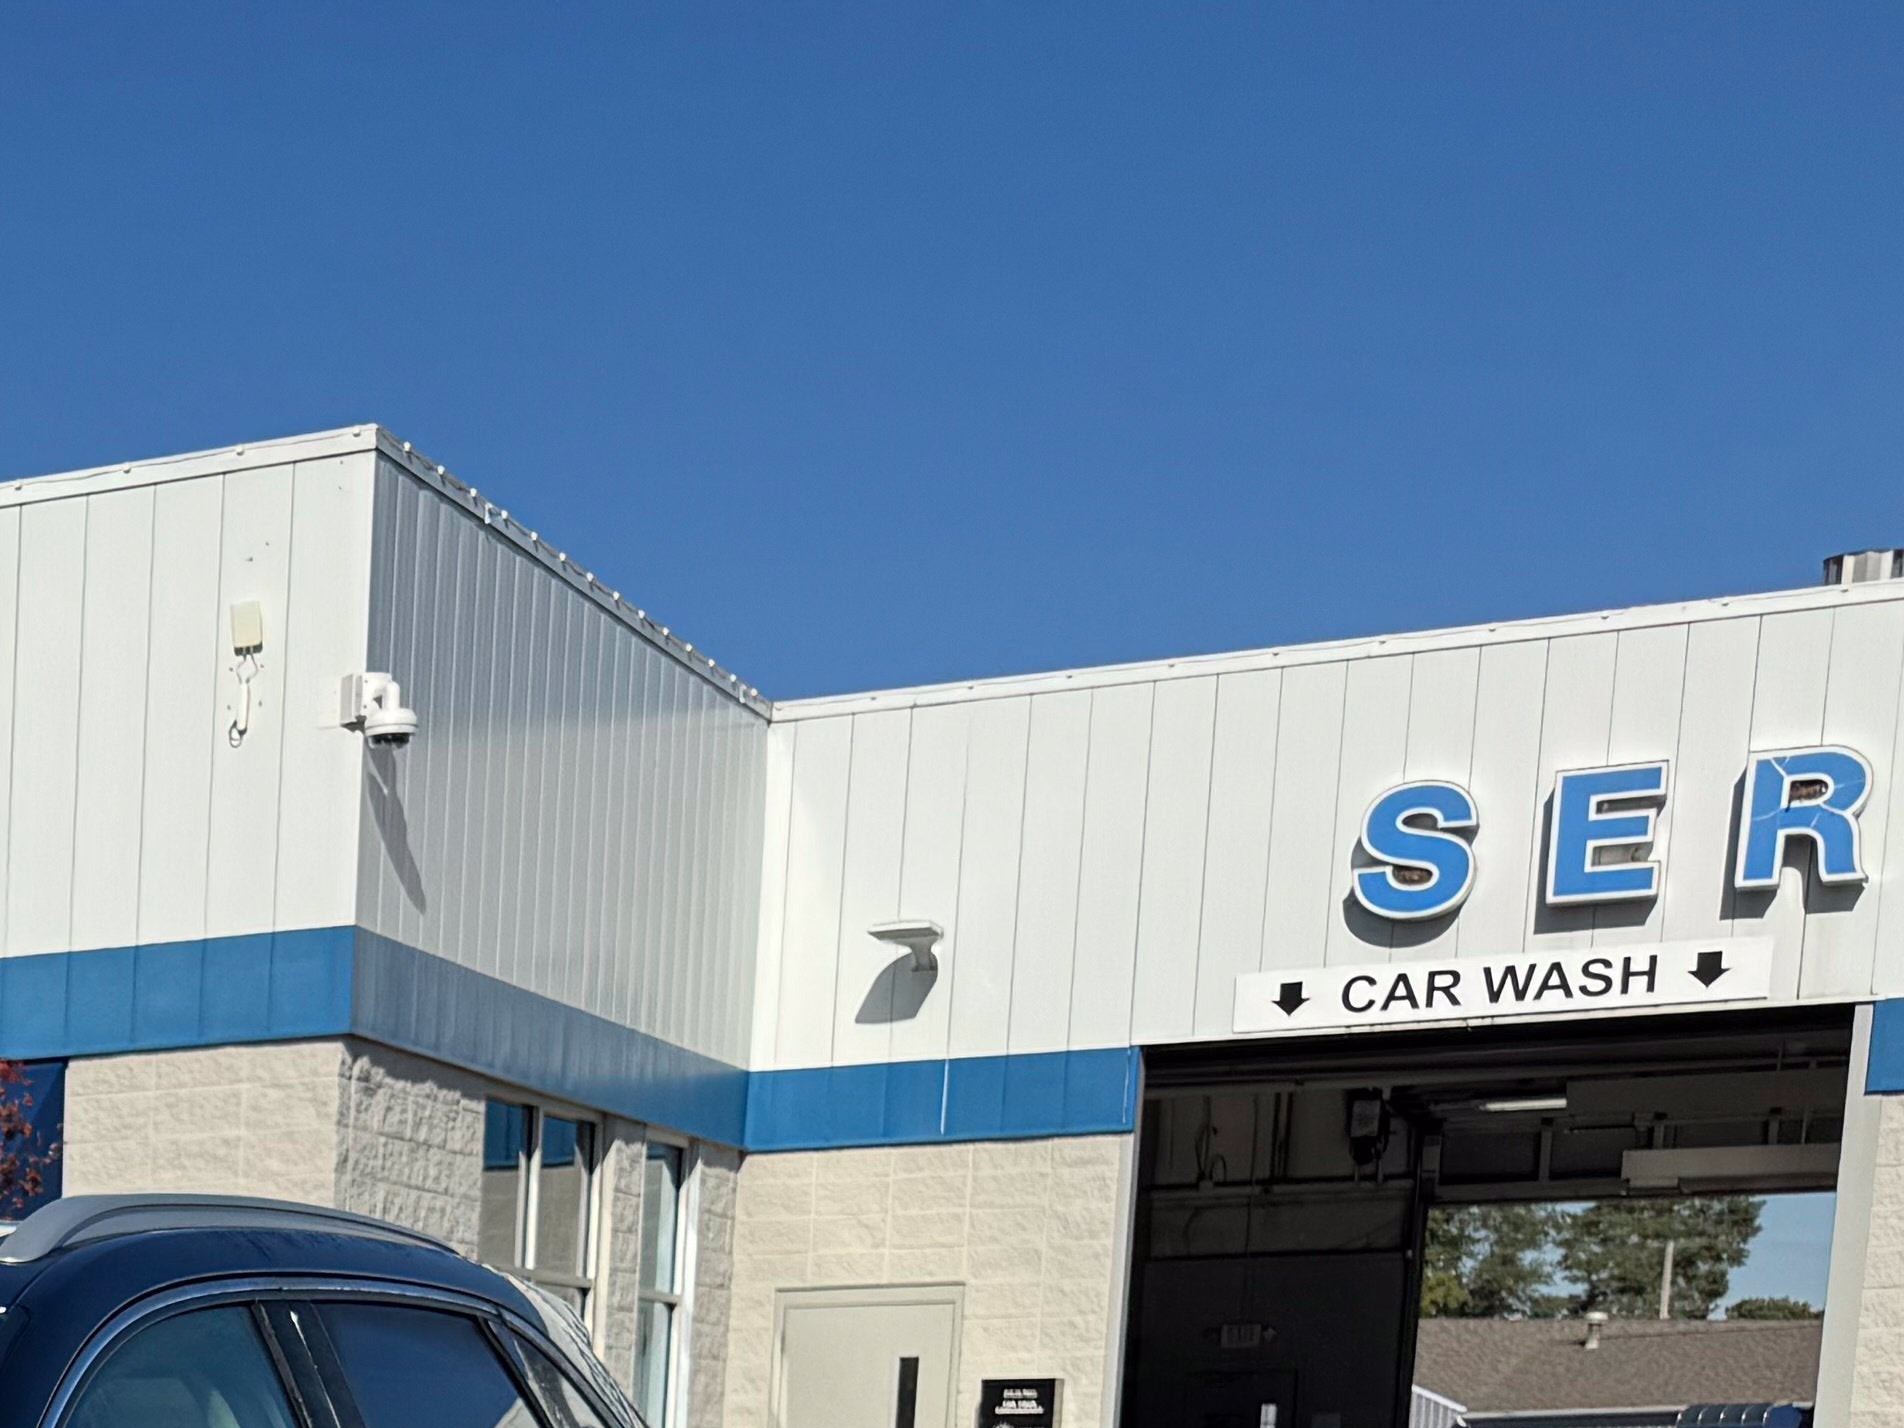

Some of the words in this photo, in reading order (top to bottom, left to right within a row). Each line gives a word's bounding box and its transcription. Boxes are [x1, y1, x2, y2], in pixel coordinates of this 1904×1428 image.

[1352, 744, 1874, 921] SER
[1341, 968, 1462, 1014] CAR
[1482, 953, 1659, 1005] WASH
